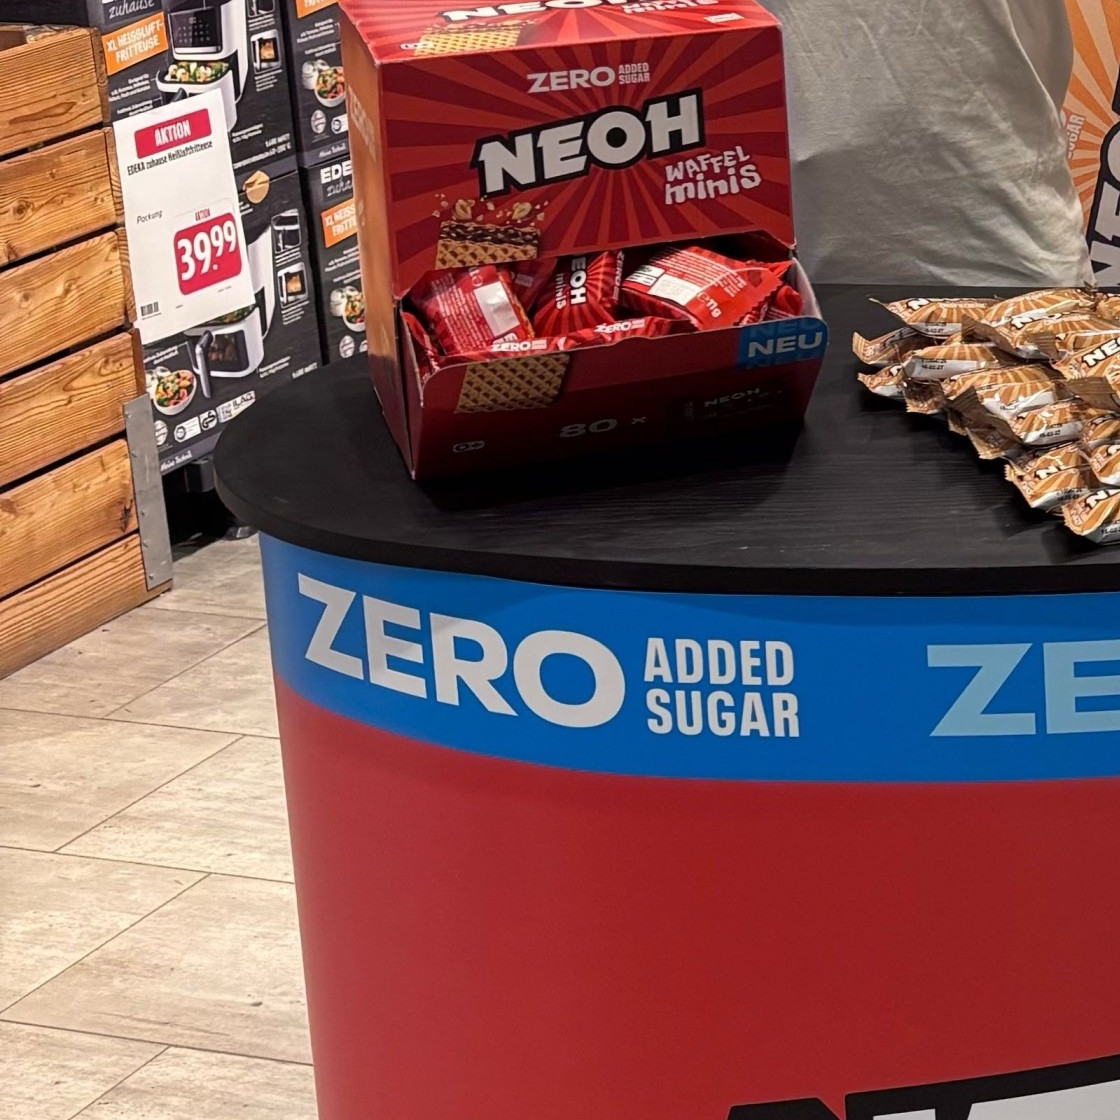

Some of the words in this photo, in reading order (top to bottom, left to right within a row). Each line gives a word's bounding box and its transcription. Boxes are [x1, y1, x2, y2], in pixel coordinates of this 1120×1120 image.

[527, 65, 616, 94] ZERO
[618, 62, 650, 75] ADDED
[618, 72, 651, 85] SUGAR
[154, 119, 192, 148] AKTION
[478, 93, 701, 195] NEOH
[320, 160, 353, 184] EDE
[665, 145, 752, 181] WAFFEL
[664, 165, 763, 206] minis
[570, 256, 587, 305] EOH
[594, 322, 632, 334] ZERO
[491, 341, 532, 353] ZERO
[748, 332, 823, 358] NEU
[559, 419, 617, 438] 80
[298, 572, 626, 729] ZERO
[643, 636, 794, 686] ADDED
[645, 689, 800, 738] SUGAR
